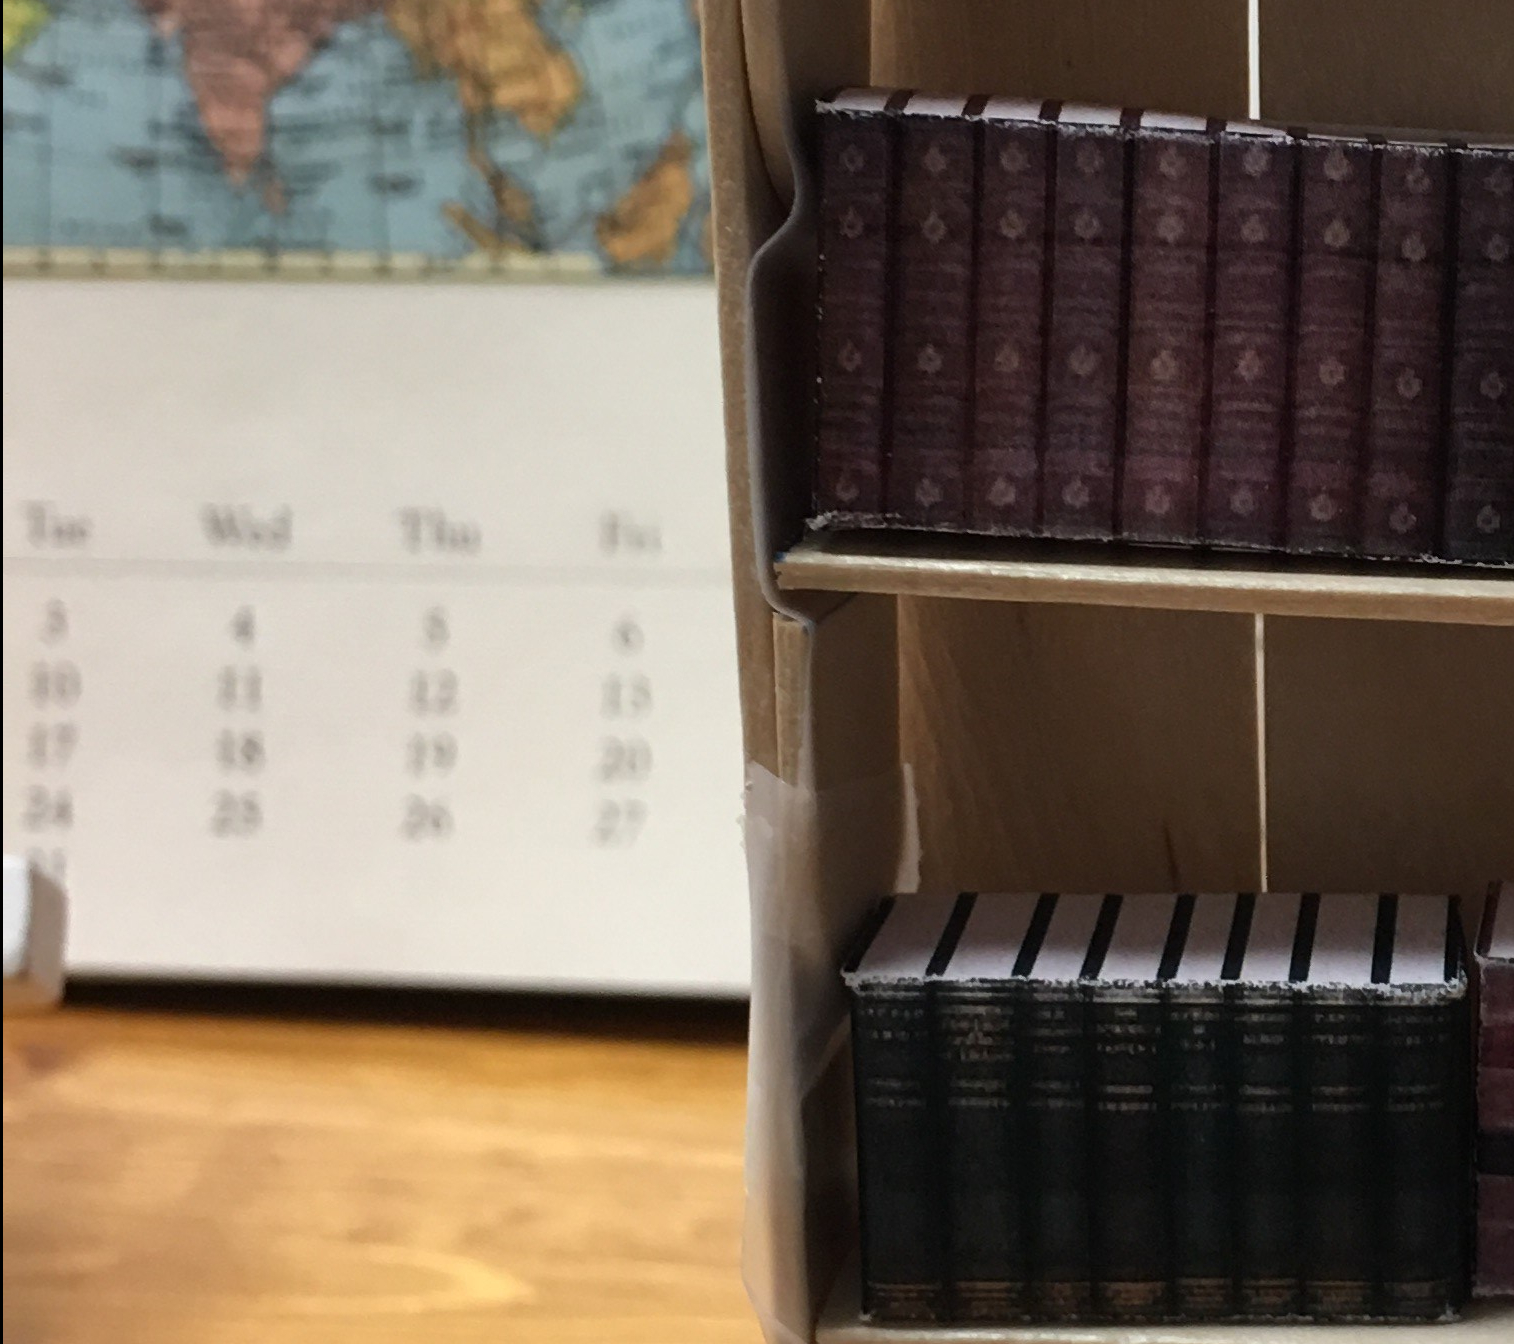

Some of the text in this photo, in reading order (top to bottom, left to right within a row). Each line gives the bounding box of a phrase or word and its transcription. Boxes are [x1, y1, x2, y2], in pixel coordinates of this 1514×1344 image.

[30, 660, 81, 710] 10
[217, 663, 262, 713] 11
[409, 667, 460, 718] 12
[28, 721, 79, 771] 17
[596, 734, 653, 785] 20
[593, 796, 648, 848] 27
